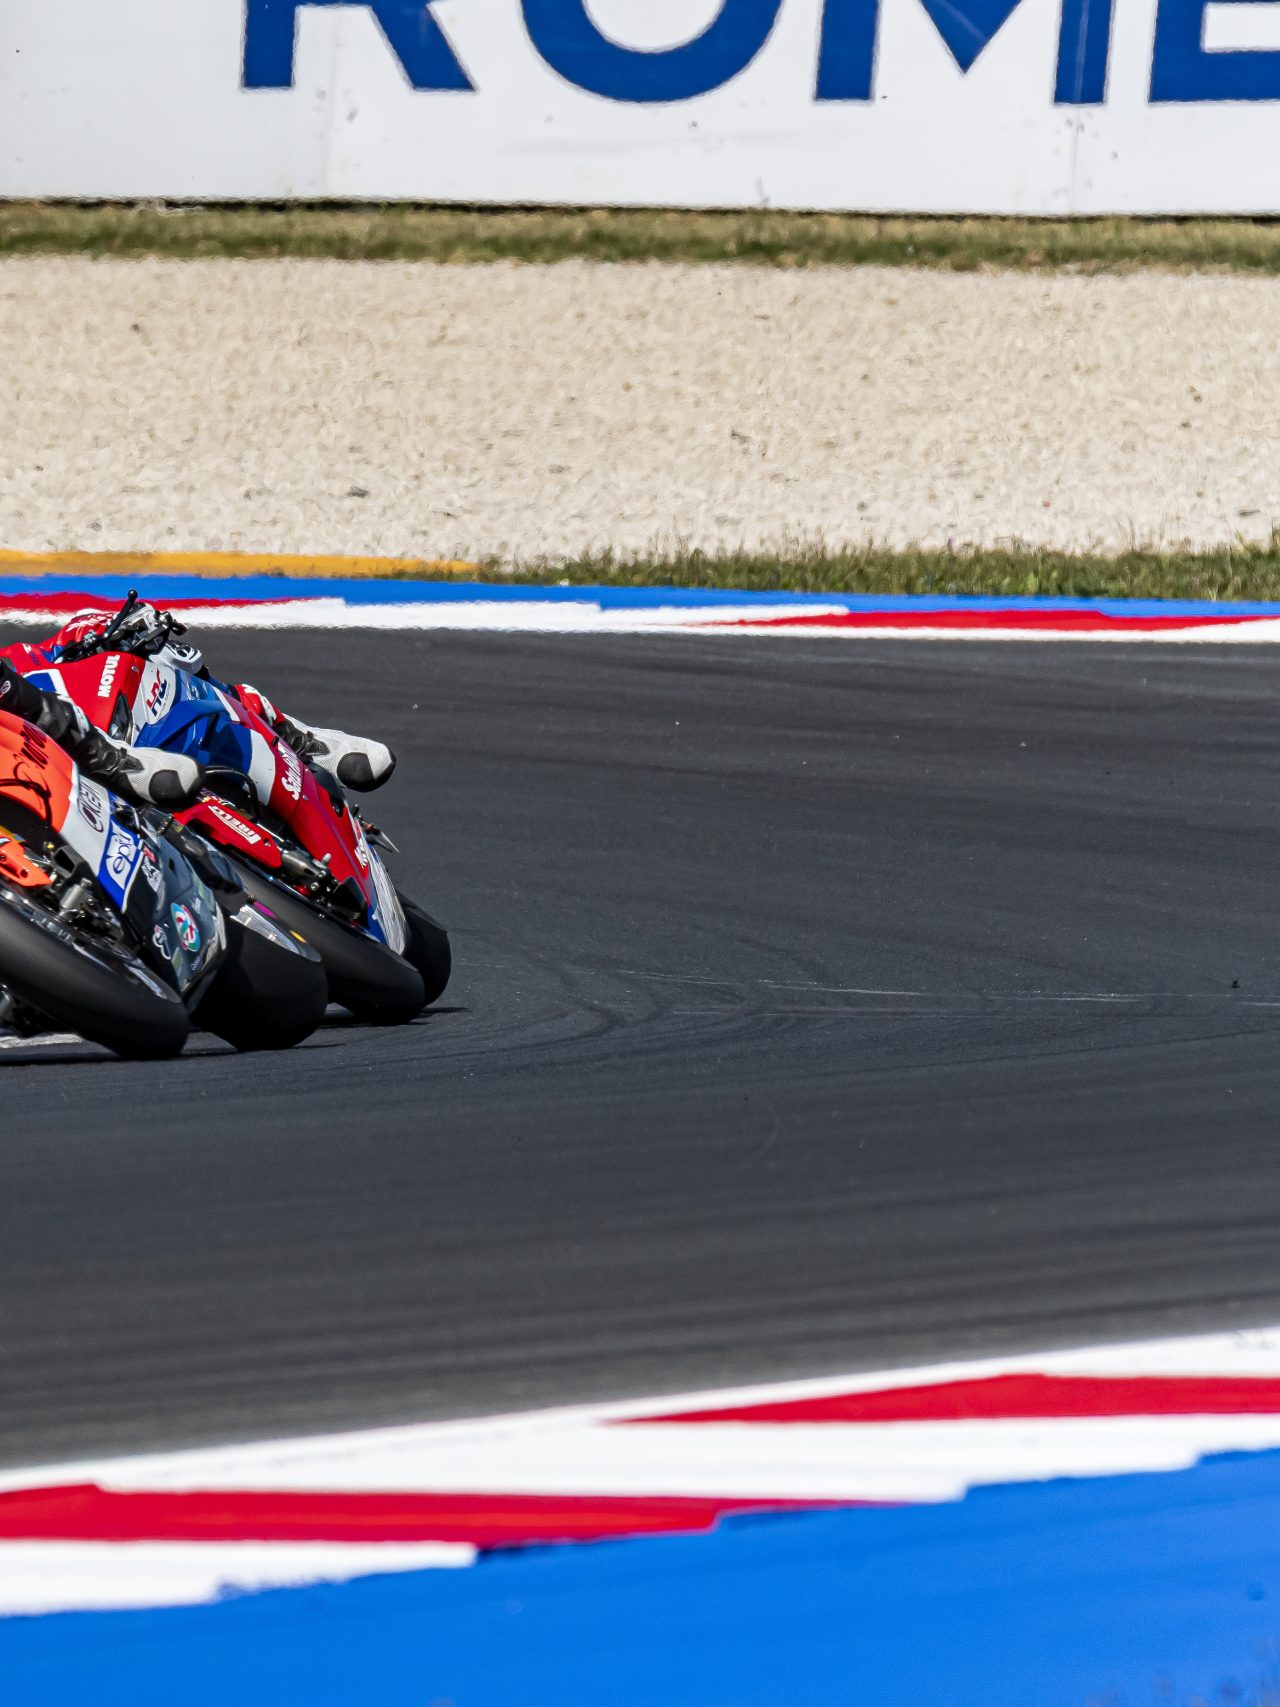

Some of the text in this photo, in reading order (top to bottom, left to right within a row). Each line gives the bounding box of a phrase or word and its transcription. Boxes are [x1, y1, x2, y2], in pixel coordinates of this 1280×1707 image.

[98, 654, 120, 698] MOTUL
[146, 668, 169, 718] HRC
[208, 805, 262, 845] PIRELLI
